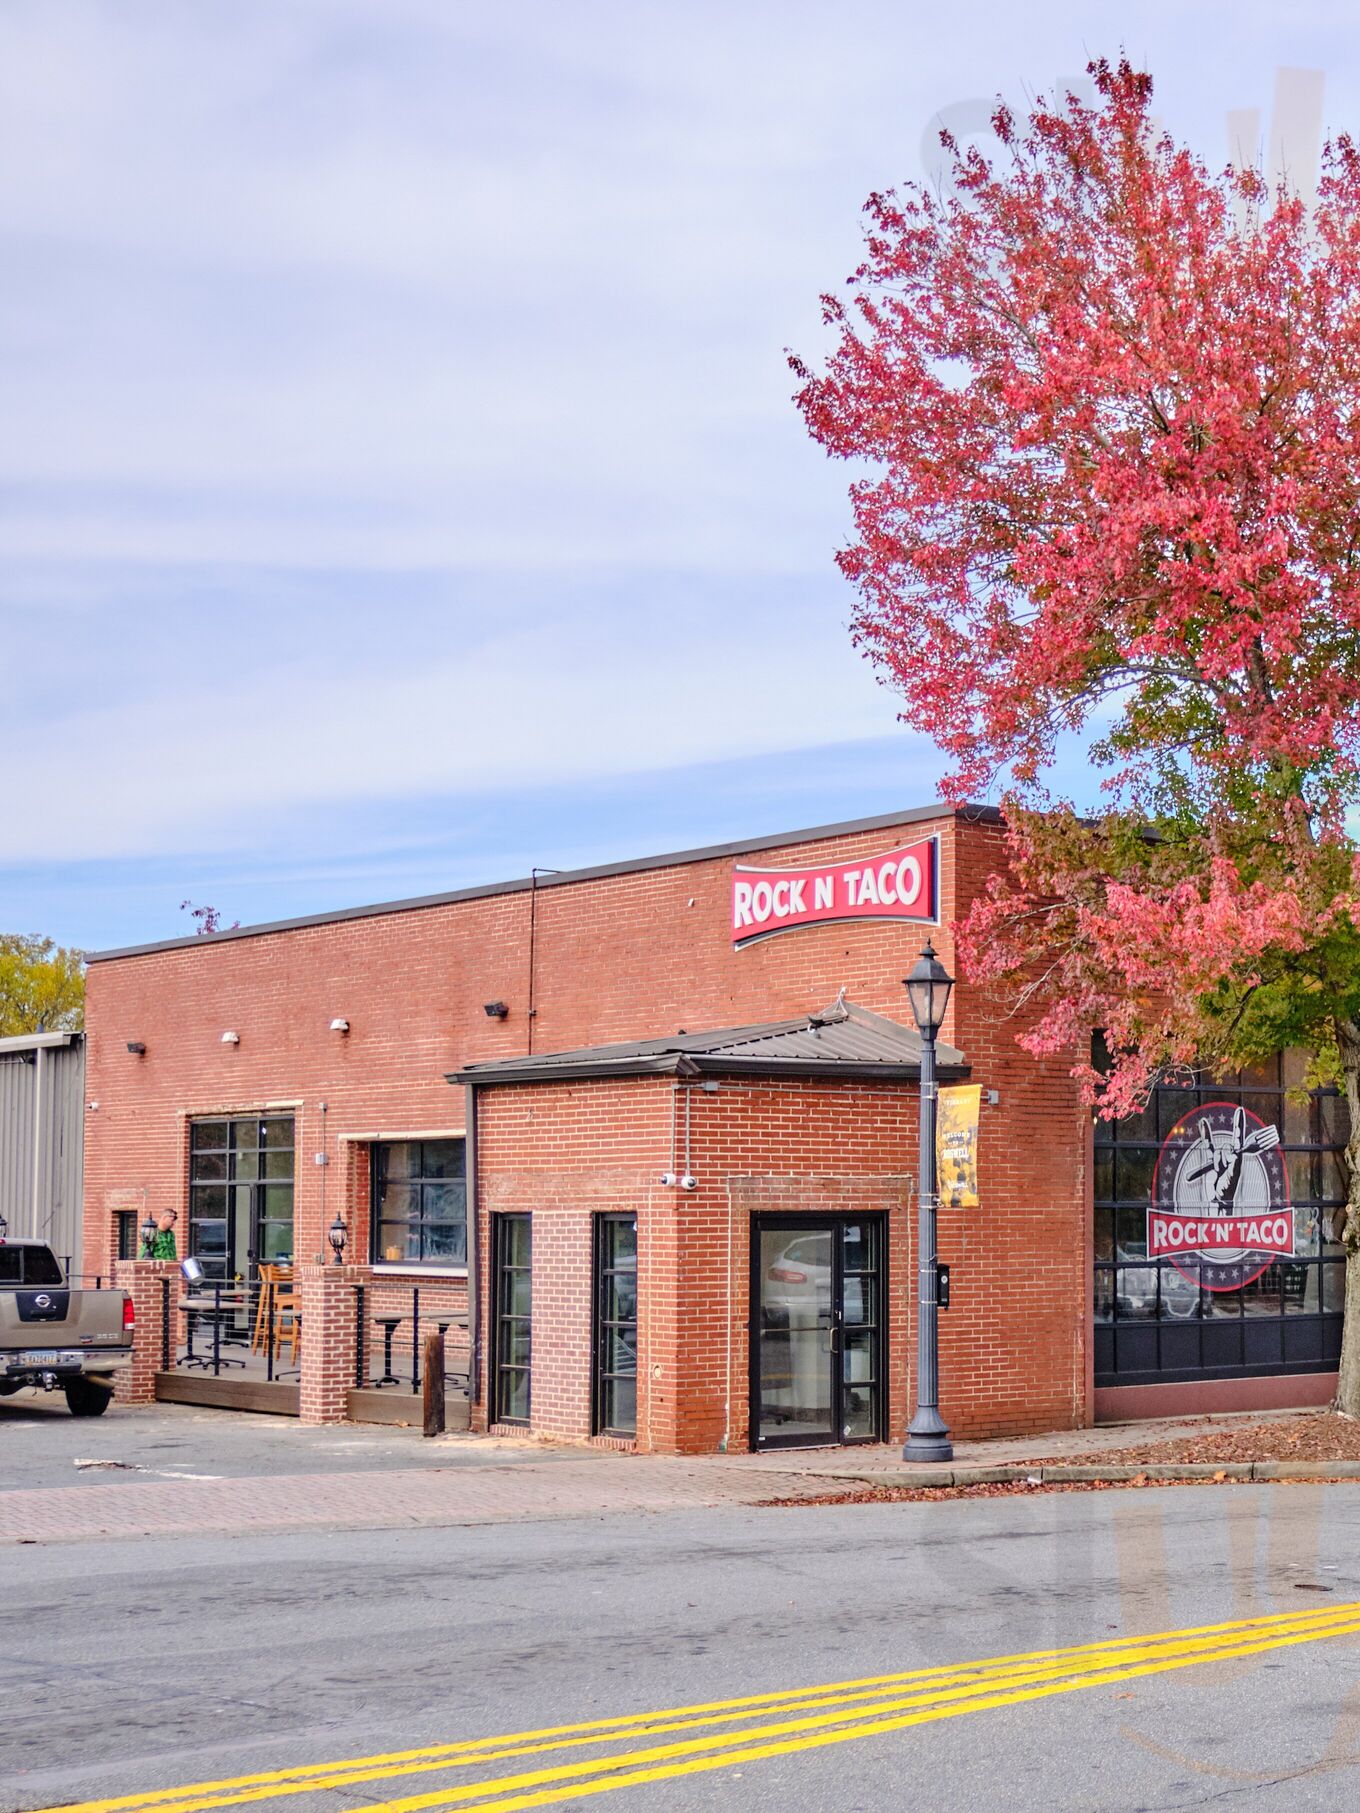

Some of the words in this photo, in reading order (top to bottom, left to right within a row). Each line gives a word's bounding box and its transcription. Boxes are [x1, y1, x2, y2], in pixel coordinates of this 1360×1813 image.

[733, 881, 807, 929] ROCK
[814, 875, 834, 910] N
[843, 855, 922, 906] TACO
[1153, 1219, 1210, 1249] ROCK
[1236, 1217, 1289, 1245] TACO
